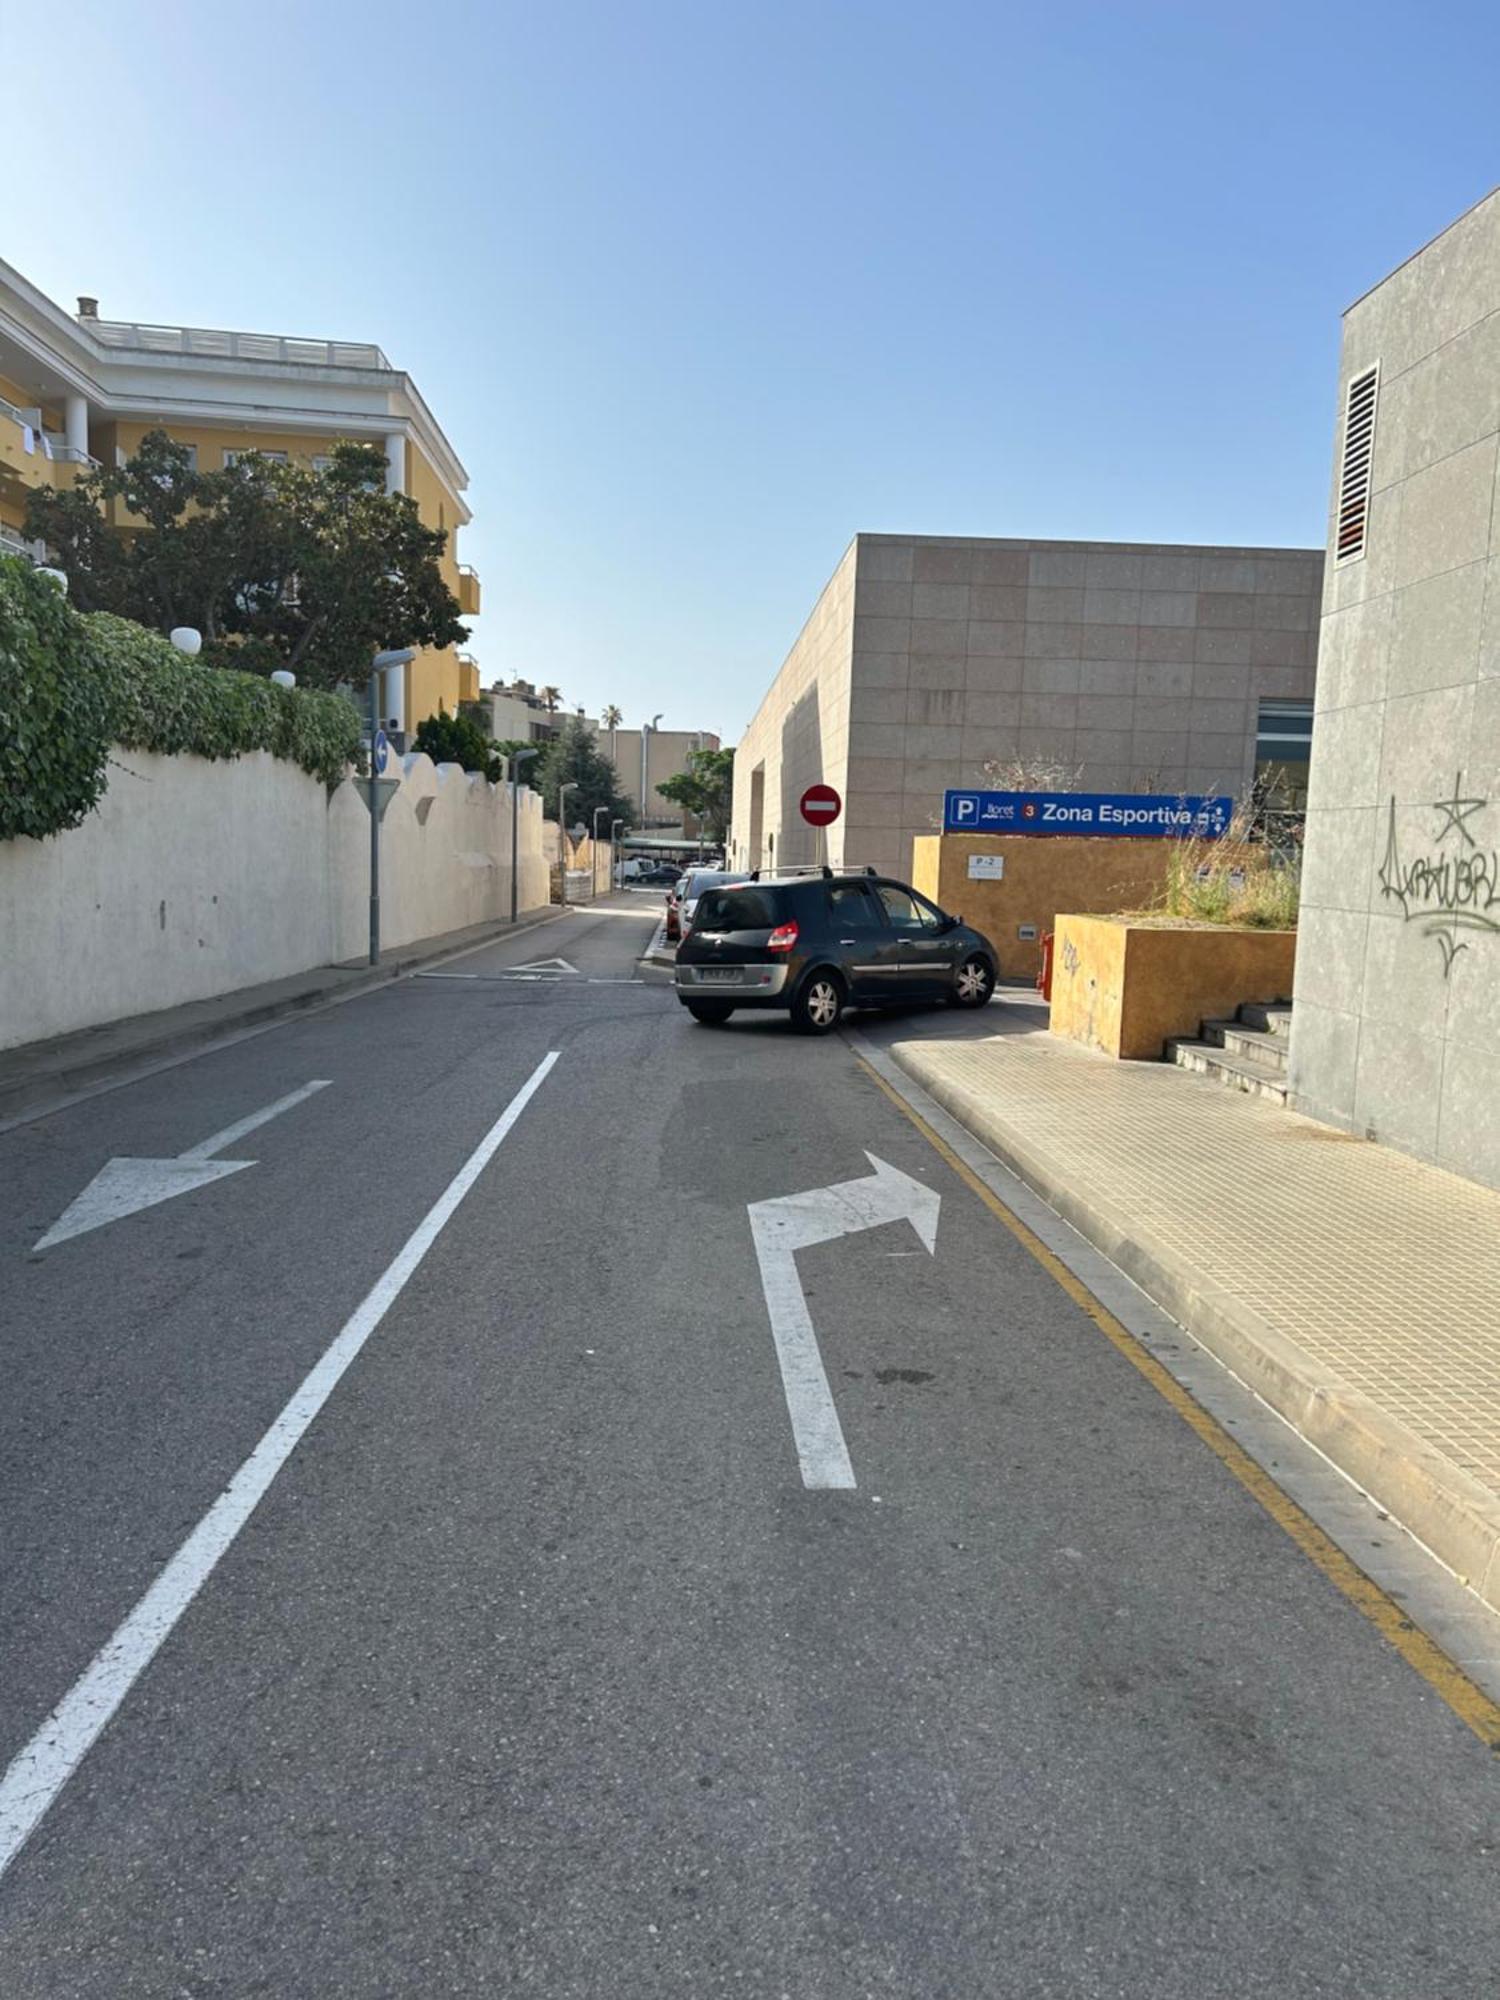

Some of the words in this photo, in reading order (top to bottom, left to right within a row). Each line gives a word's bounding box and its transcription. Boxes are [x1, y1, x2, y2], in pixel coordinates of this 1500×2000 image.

[957, 799, 974, 821] P
[1025, 805, 1035, 817] 3
[1042, 804, 1093, 822] Zona
[1099, 805, 1191, 826] Esportiva
